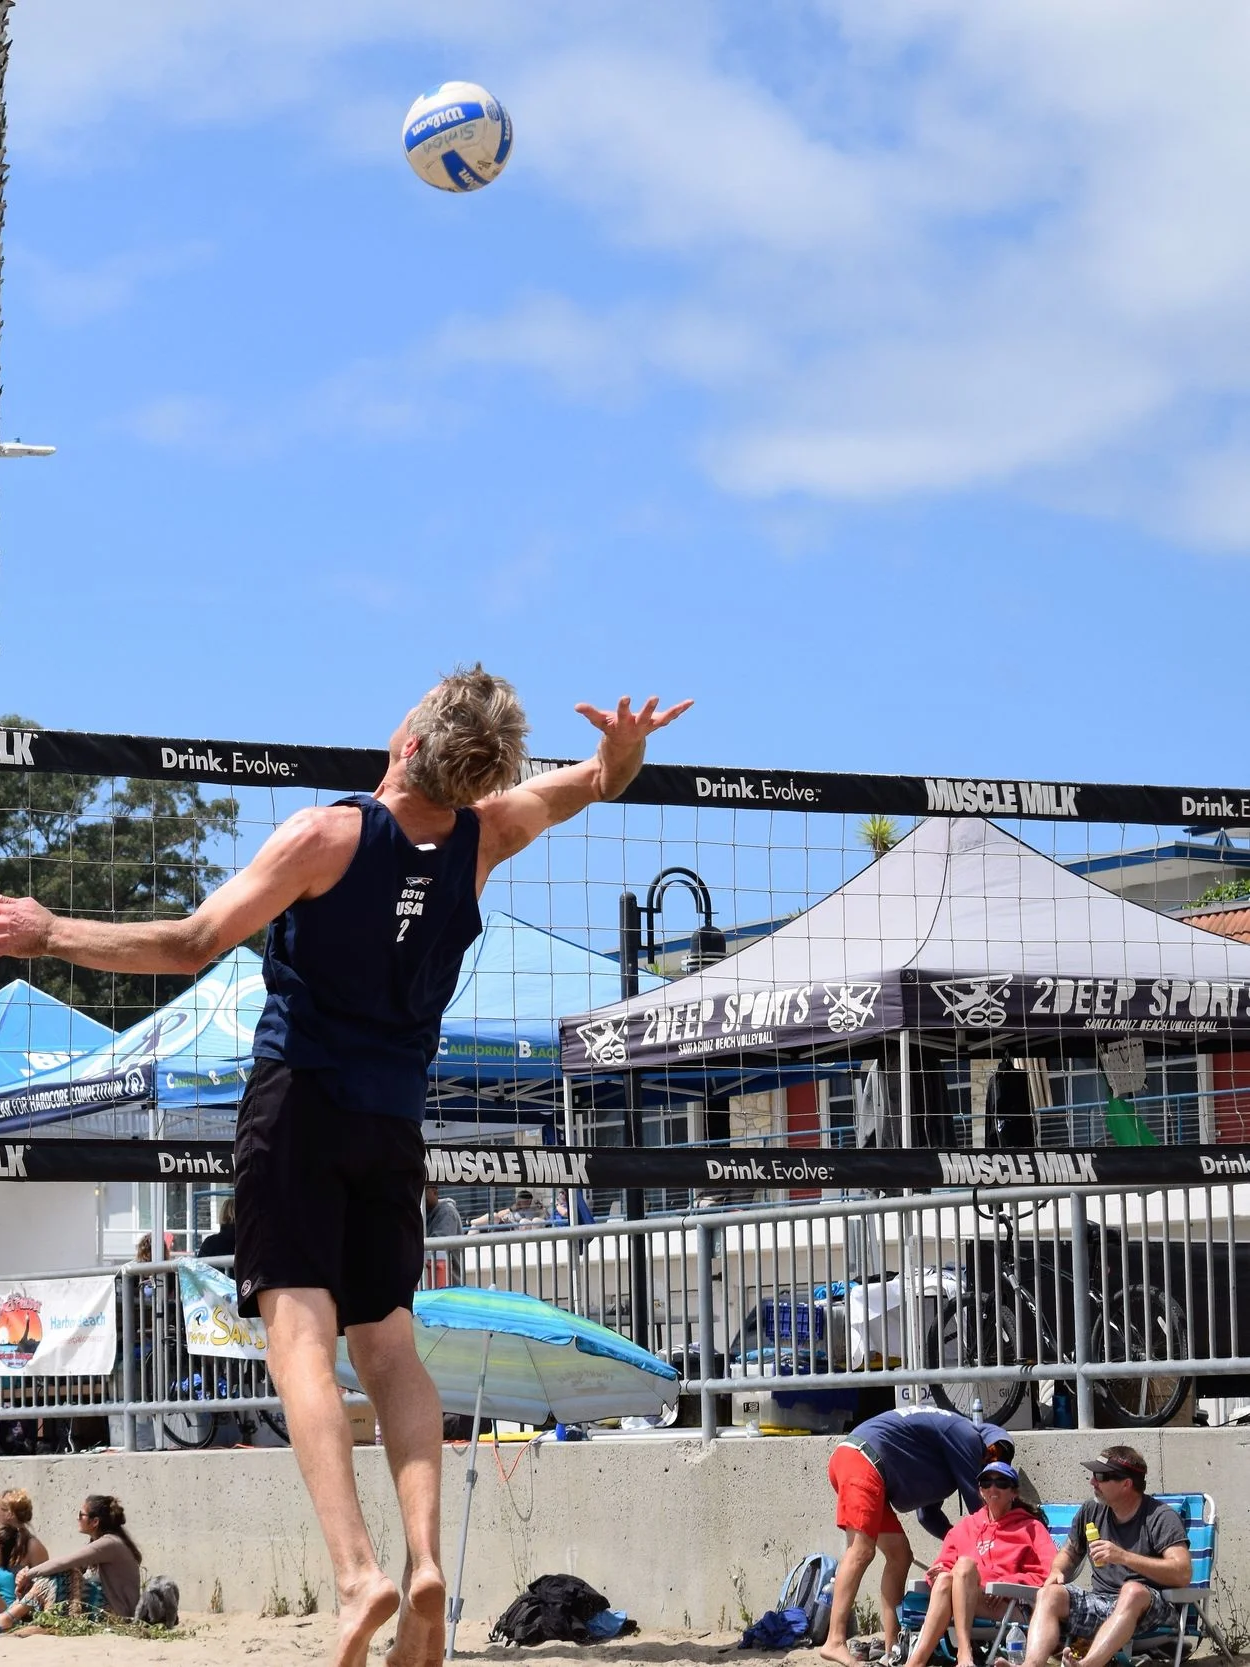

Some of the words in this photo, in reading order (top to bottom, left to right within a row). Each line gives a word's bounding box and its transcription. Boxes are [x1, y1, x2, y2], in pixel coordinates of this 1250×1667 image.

[410, 106, 466, 136] Wilson
[161, 747, 228, 773] Drink.
[696, 777, 759, 799] Drink.
[926, 779, 1018, 814] MUSCLE
[1022, 783, 1080, 816] MILK
[1181, 796, 1239, 818] Drink.
[396, 901, 424, 916] USA
[396, 918, 410, 942] 2
[1030, 976, 1137, 1015] 2DEEP
[640, 998, 714, 1046] 2DEEP
[722, 985, 813, 1033] SPORTS
[1140, 1019, 1168, 1032] BEACH
[438, 1037, 515, 1057] CALIFORNIA
[715, 1036, 736, 1050] BEACH
[737, 1031, 774, 1047] VOLLEYBALL
[13, 1095, 29, 1115] FOR
[29, 1089, 70, 1112] HARDCORE
[70, 1079, 123, 1106] COMPETITION
[158, 1152, 230, 1175] Drink.
[424, 1148, 520, 1184] MUSCLE
[523, 1150, 590, 1185] MILK
[706, 1159, 771, 1181] Drink.
[938, 1153, 1035, 1185] MUSCLE
[1034, 1152, 1099, 1184] MILK
